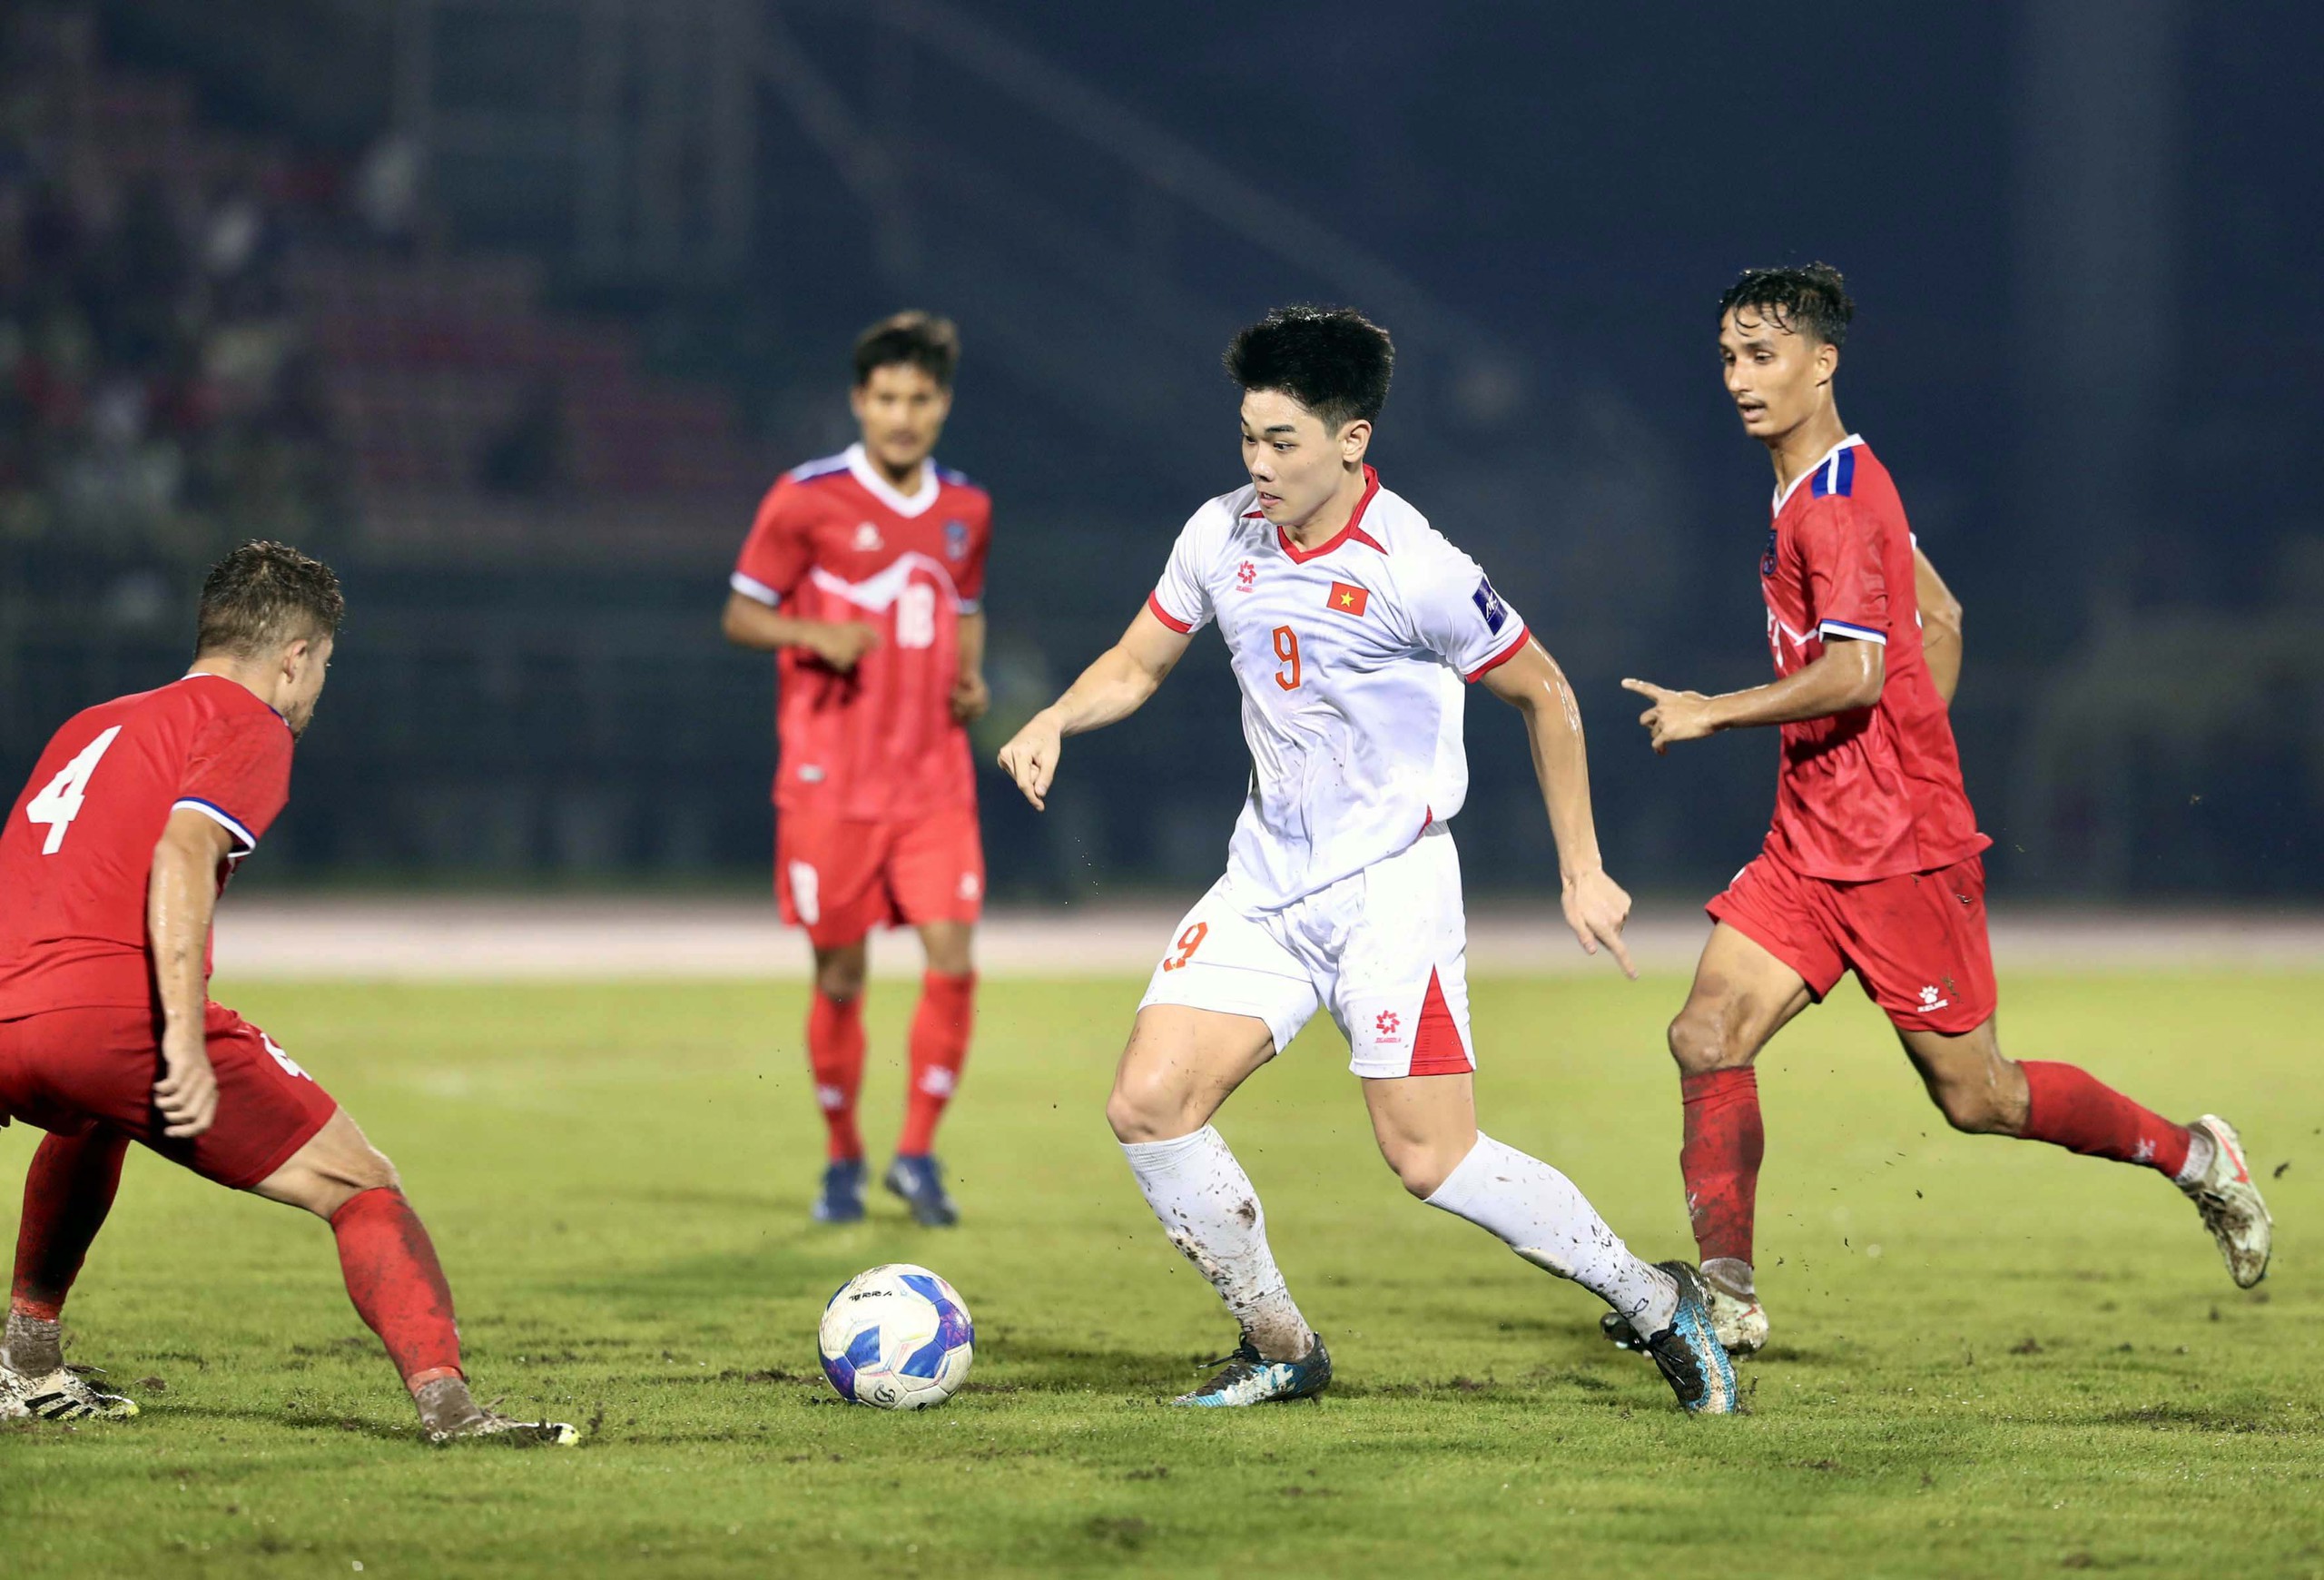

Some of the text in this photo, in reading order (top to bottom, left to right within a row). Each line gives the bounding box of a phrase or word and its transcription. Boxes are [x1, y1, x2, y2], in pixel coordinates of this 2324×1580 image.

[1272, 625, 1301, 691] 9
[25, 725, 123, 855] 4
[1163, 922, 1208, 973] 9
